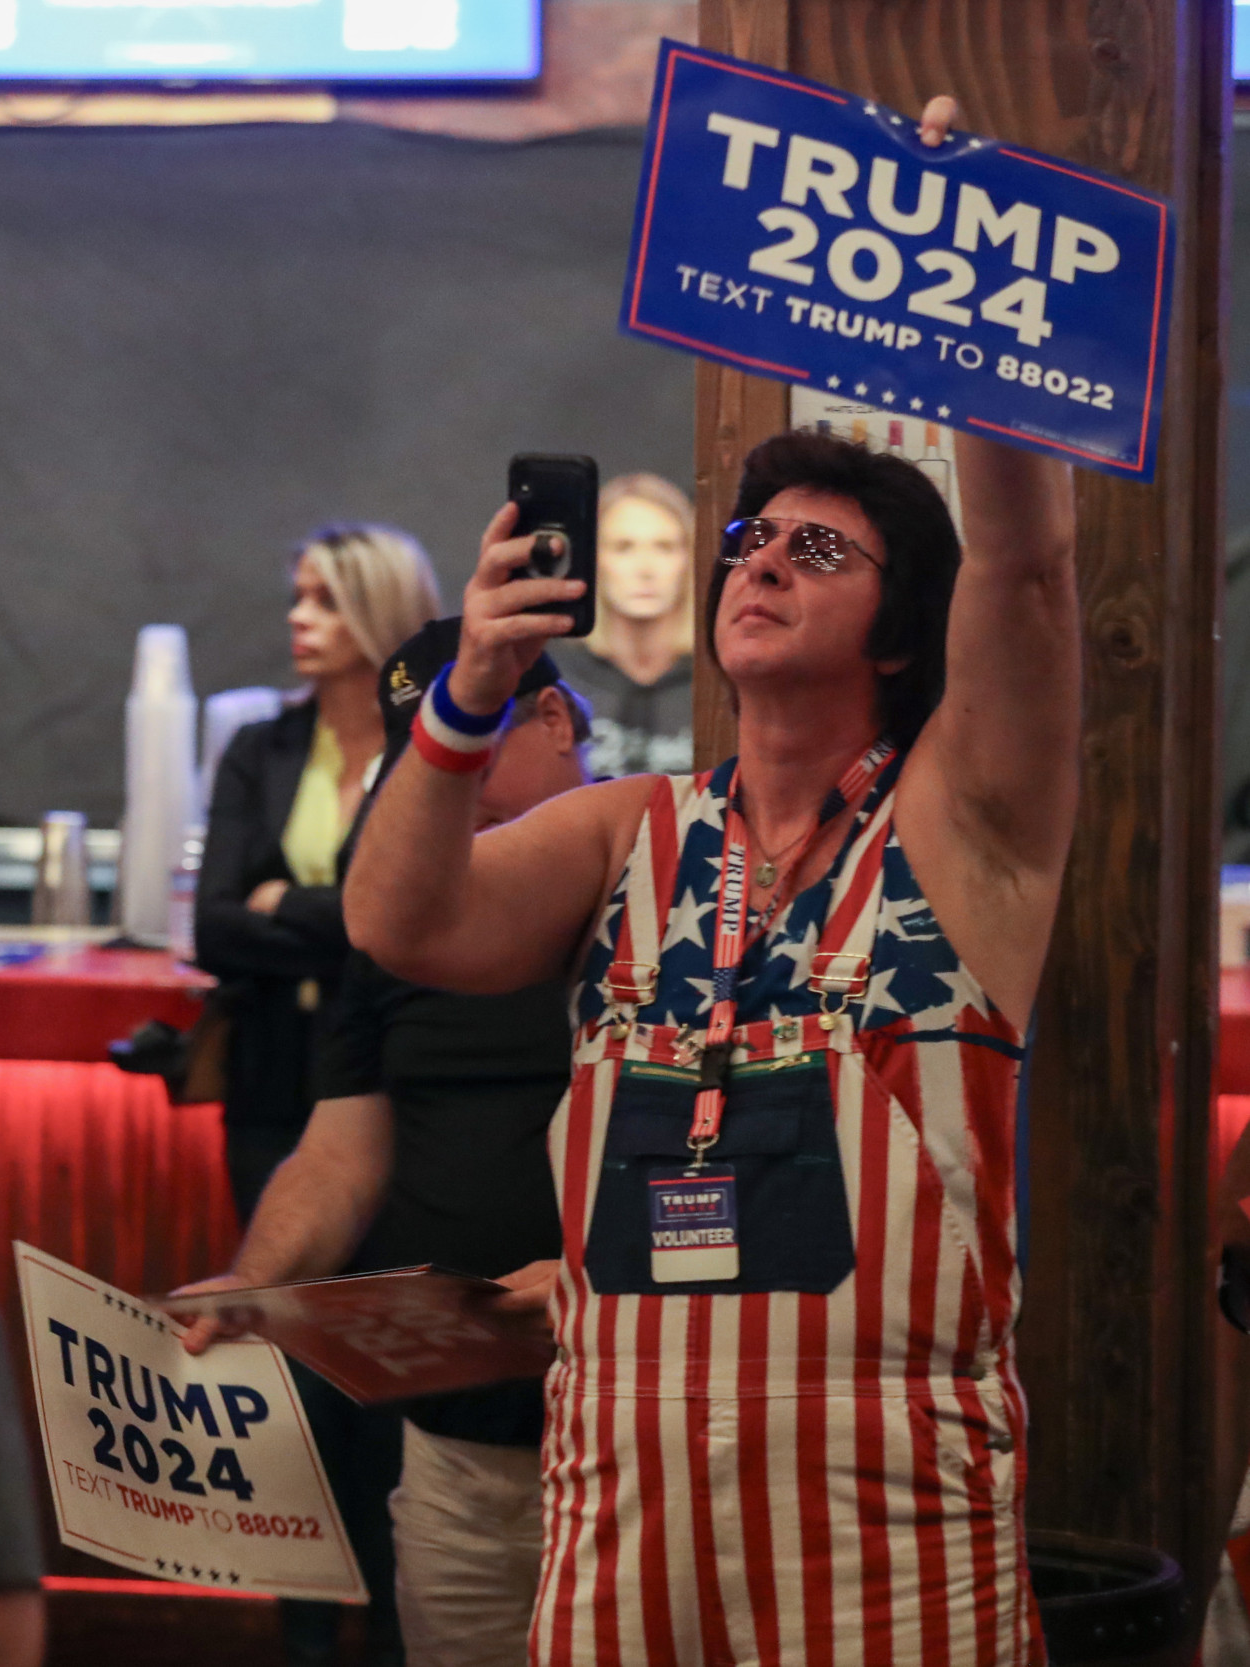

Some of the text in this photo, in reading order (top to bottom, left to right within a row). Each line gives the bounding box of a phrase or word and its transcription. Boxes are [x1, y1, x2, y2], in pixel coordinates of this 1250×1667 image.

[707, 112, 1120, 284] TRUMP
[748, 207, 1052, 347] 2024
[676, 265, 1115, 410] TEXT TRUMP TO 88022
[723, 847, 745, 931] TRUMP
[652, 1228, 734, 1247] VOLUNTEER
[661, 1194, 721, 1205] TRUMP
[49, 1317, 270, 1439] TRUMP
[63, 1460, 324, 1542] TEXT TRUMP TO 88022
[88, 1407, 255, 1501] 2024
